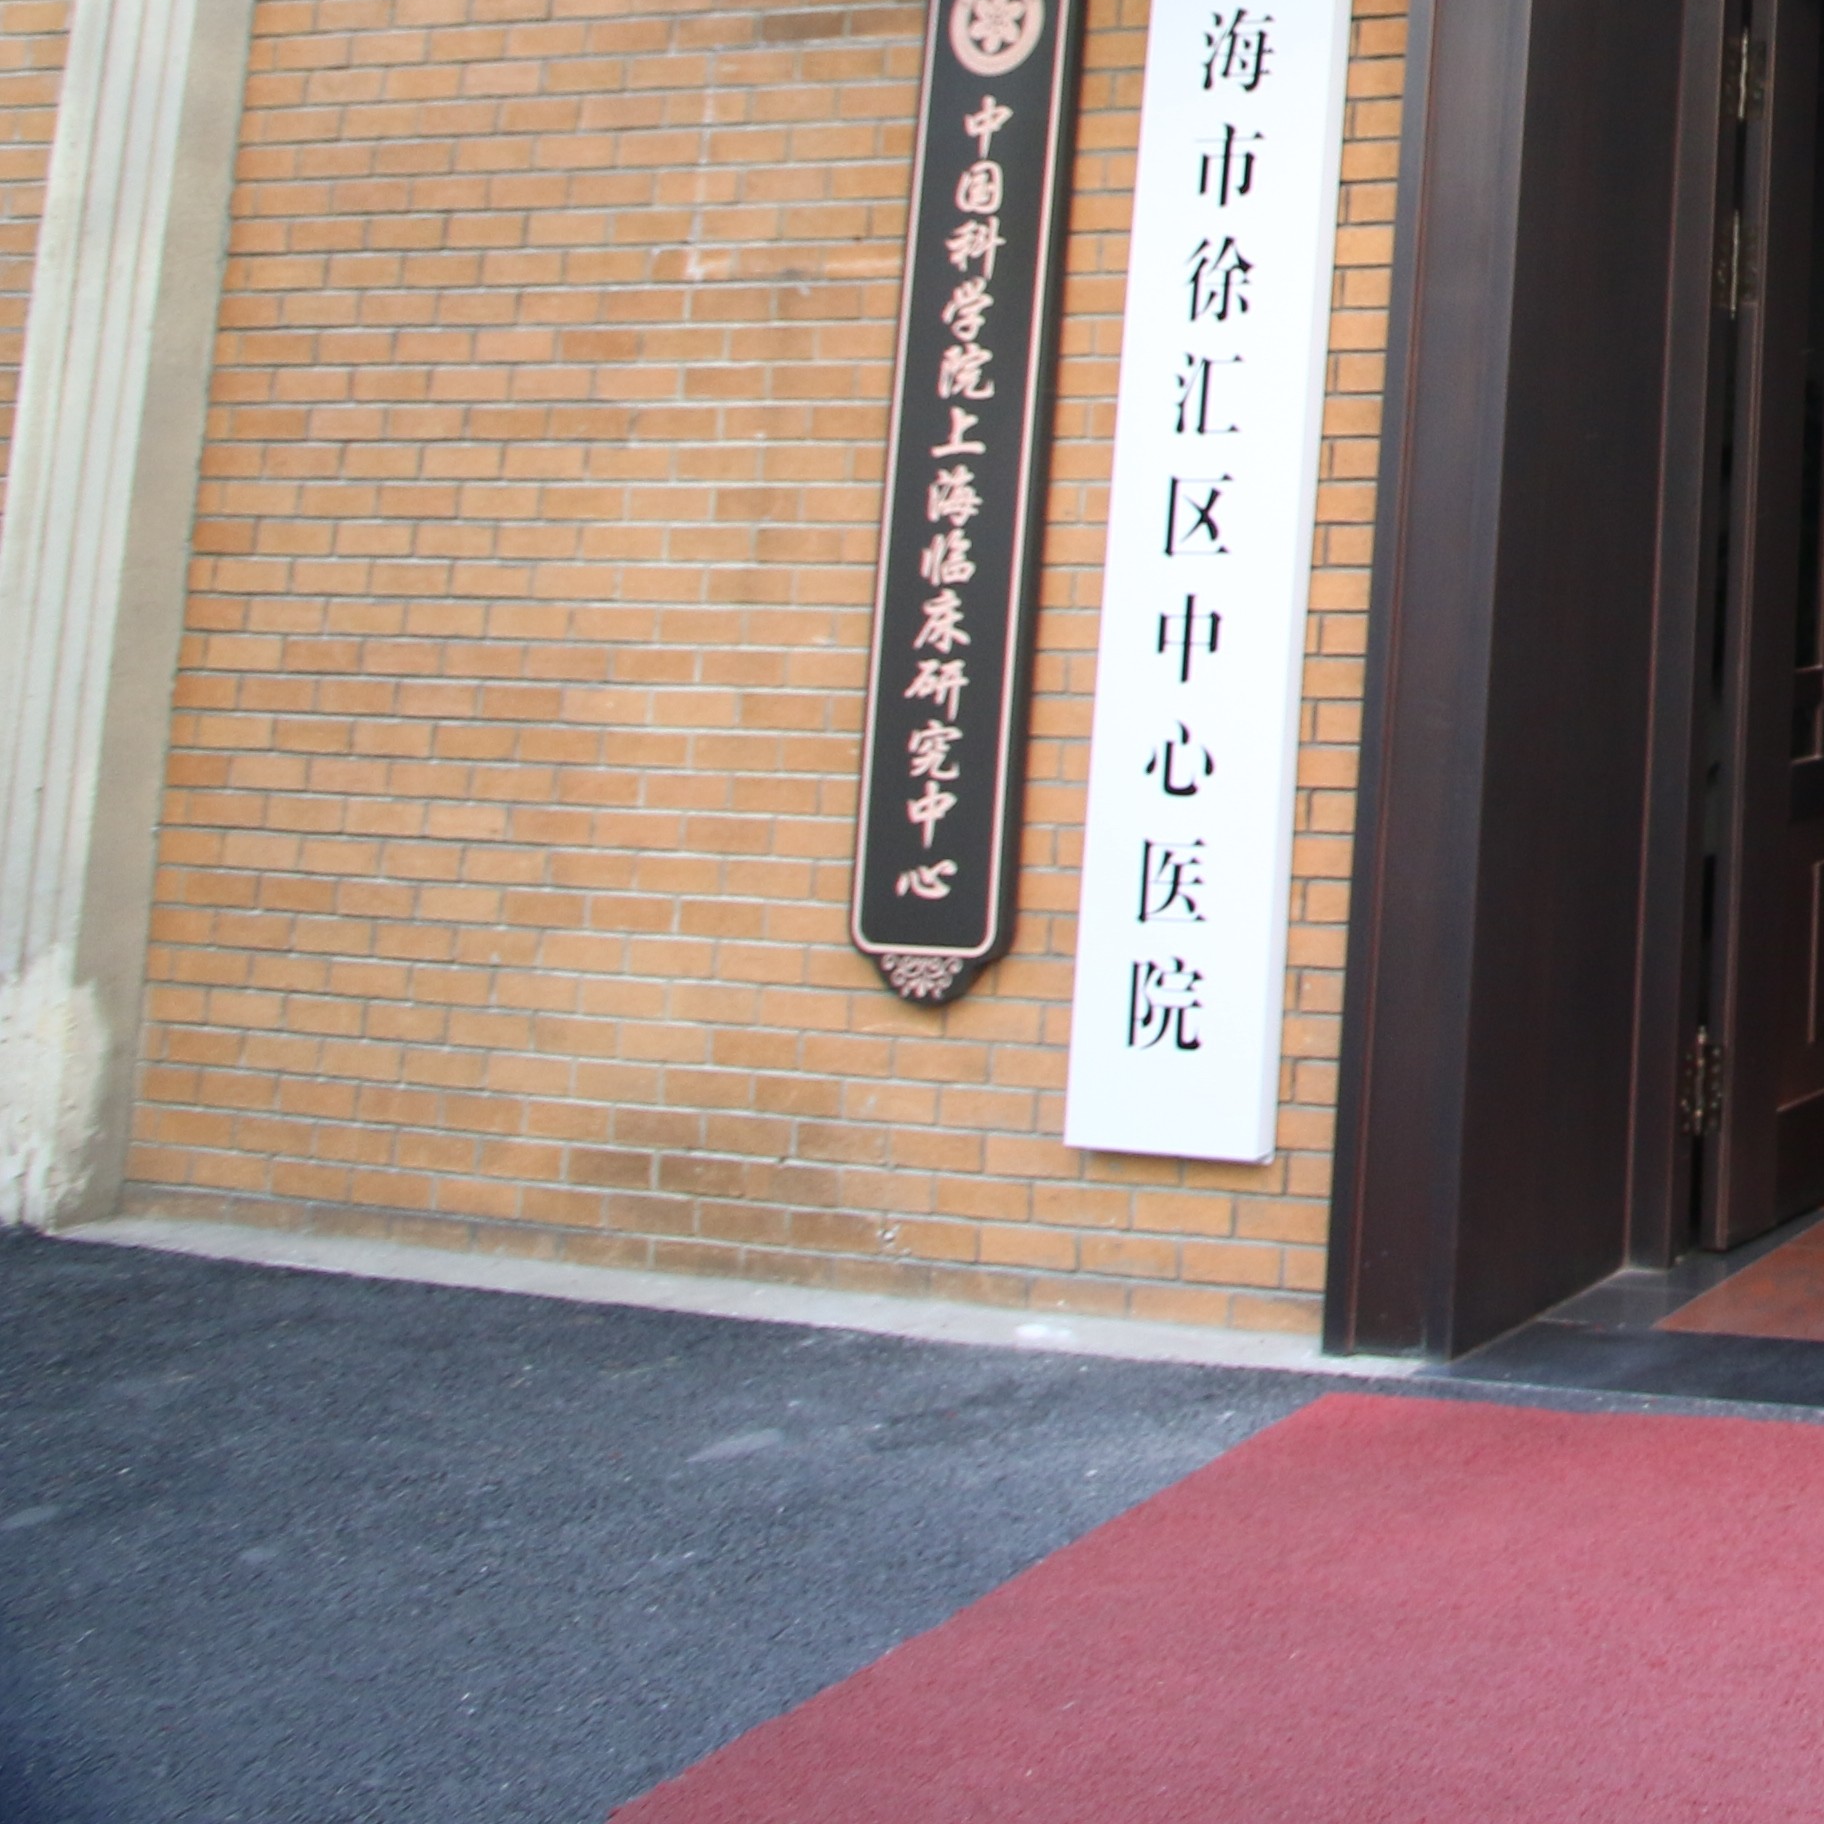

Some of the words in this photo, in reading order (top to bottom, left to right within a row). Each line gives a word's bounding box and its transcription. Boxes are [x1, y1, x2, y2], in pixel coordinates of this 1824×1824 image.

[894, 94, 1014, 900] 中国科学院上海临床研究中心
